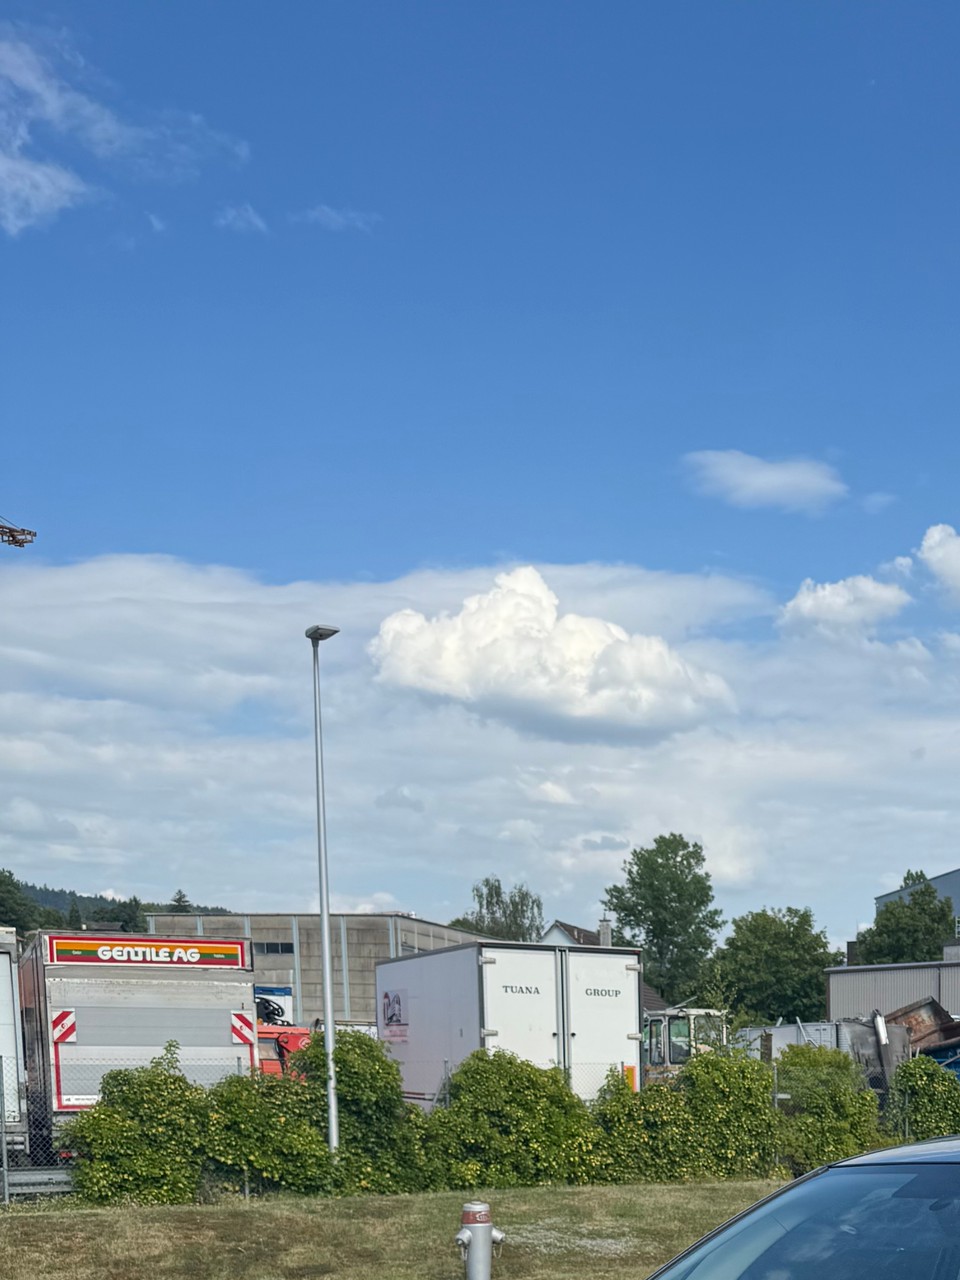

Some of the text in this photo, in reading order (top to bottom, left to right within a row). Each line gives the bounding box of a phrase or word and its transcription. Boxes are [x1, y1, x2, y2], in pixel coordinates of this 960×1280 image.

[97, 945, 201, 963] GENTILE AG
[502, 985, 621, 998] TUANA GROUP
